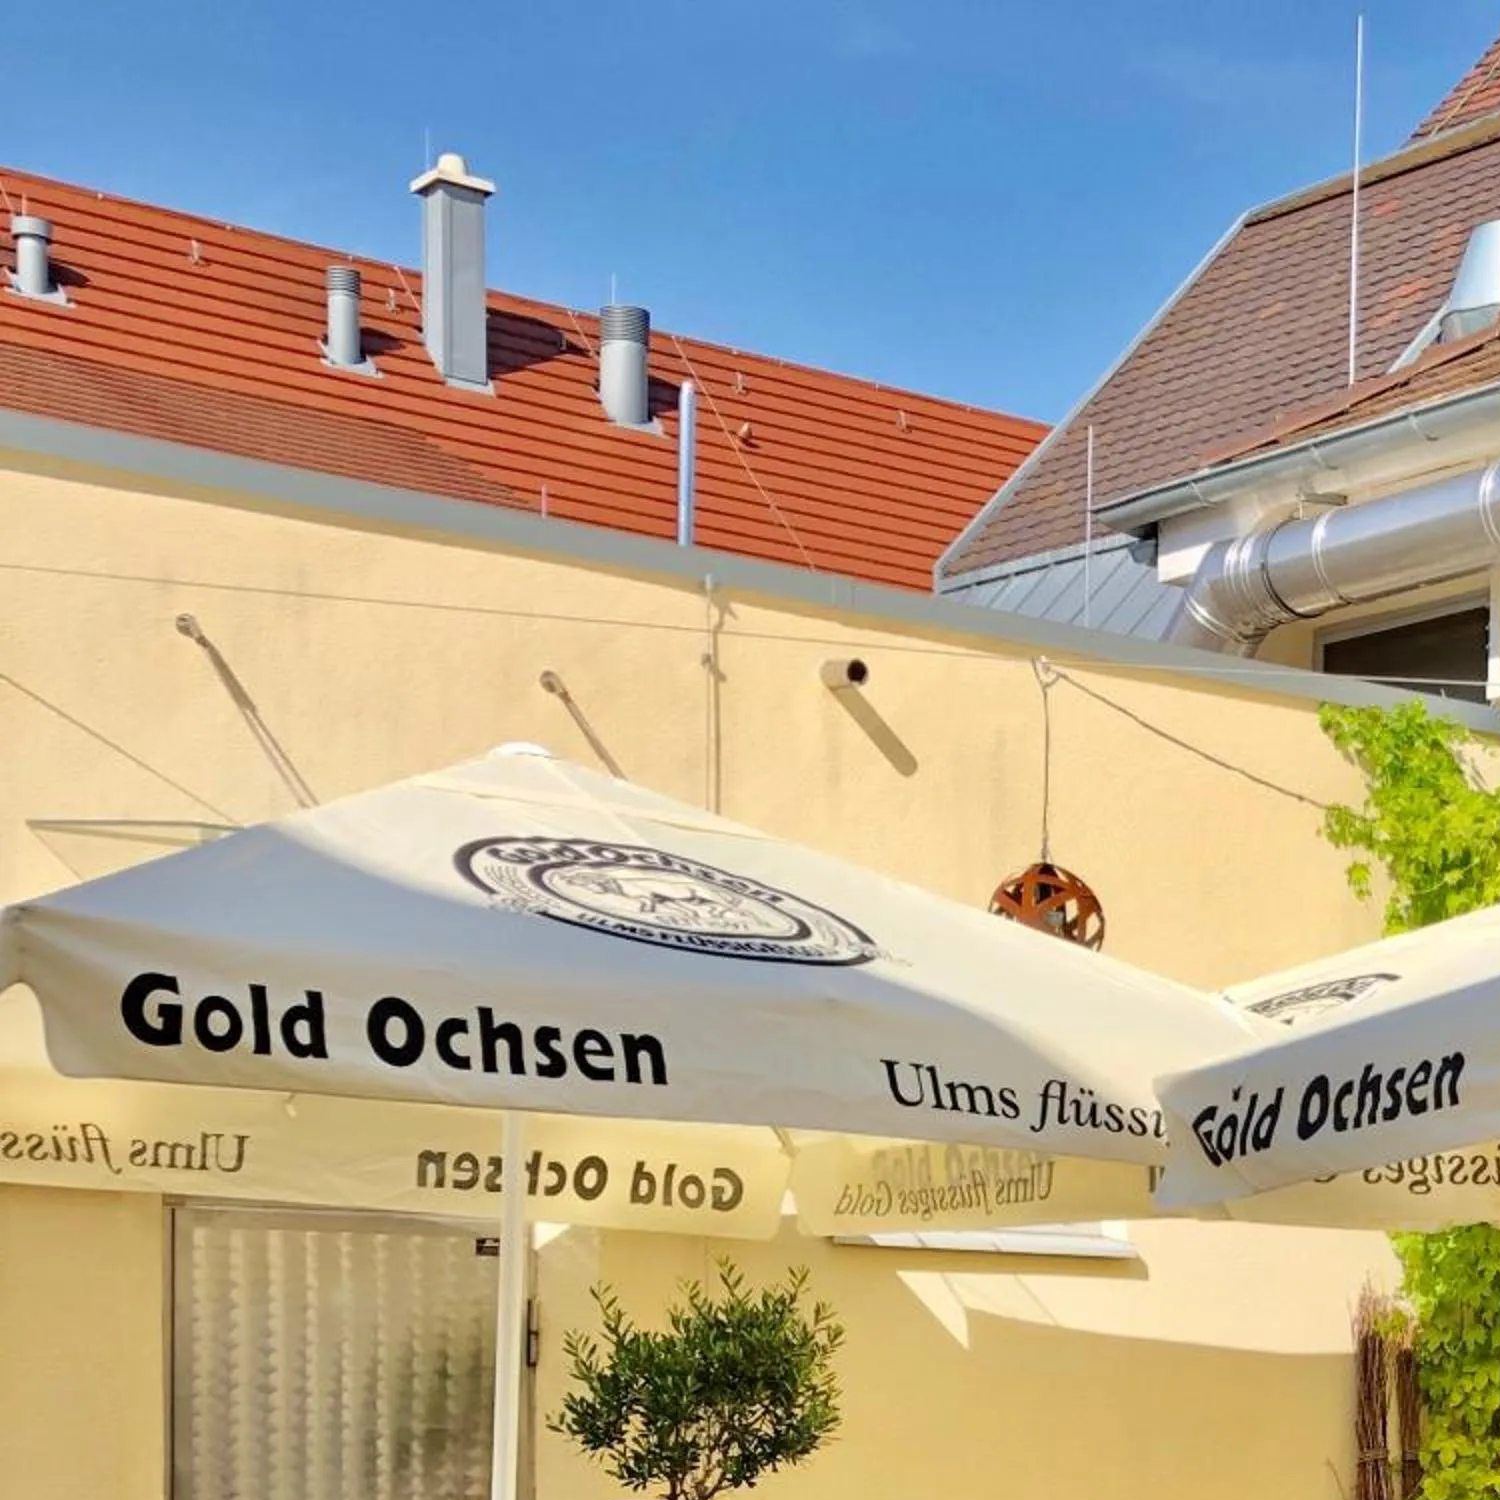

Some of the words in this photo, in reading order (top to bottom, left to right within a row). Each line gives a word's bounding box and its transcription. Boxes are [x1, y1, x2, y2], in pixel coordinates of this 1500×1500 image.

[121, 972, 328, 1059] Gold
[367, 996, 668, 1085] Ochsen
[880, 1058, 1020, 1120] Ulms
[1030, 1079, 1168, 1146] flüssi
[1192, 1085, 1285, 1168] Gold
[1297, 1051, 1466, 1142] Ochsen
